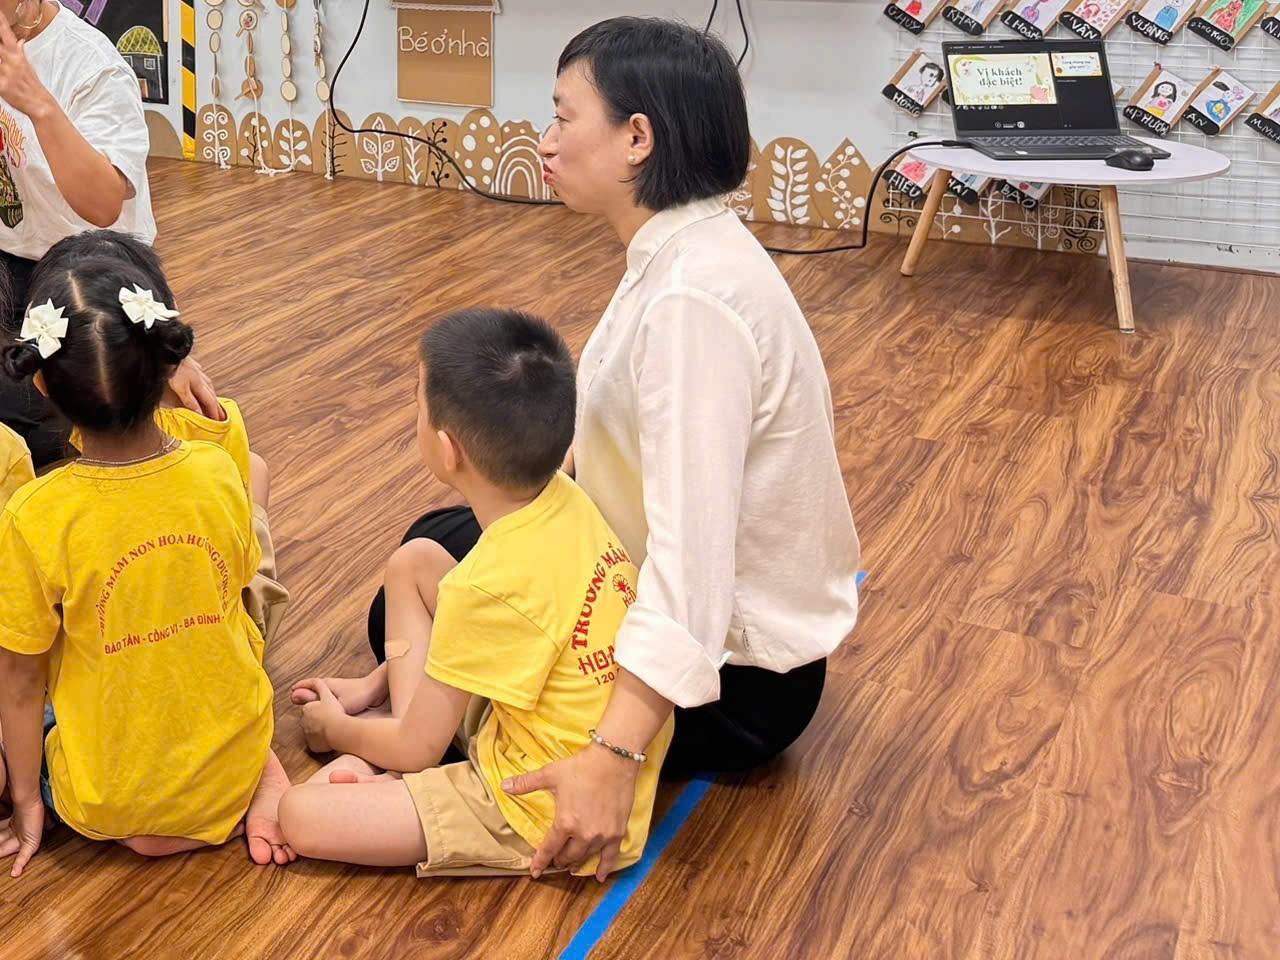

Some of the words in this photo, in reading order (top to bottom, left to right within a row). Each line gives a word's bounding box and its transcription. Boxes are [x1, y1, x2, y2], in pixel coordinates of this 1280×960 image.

[397, 25, 428, 53] Bé
[448, 28, 490, 57] nhà
[976, 68, 989, 80] Vị
[991, 67, 1022, 77] khách
[128, 540, 156, 561] NON
[158, 534, 184, 547] HOA
[184, 617, 195, 628] BA
[594, 672, 615, 686] 120
